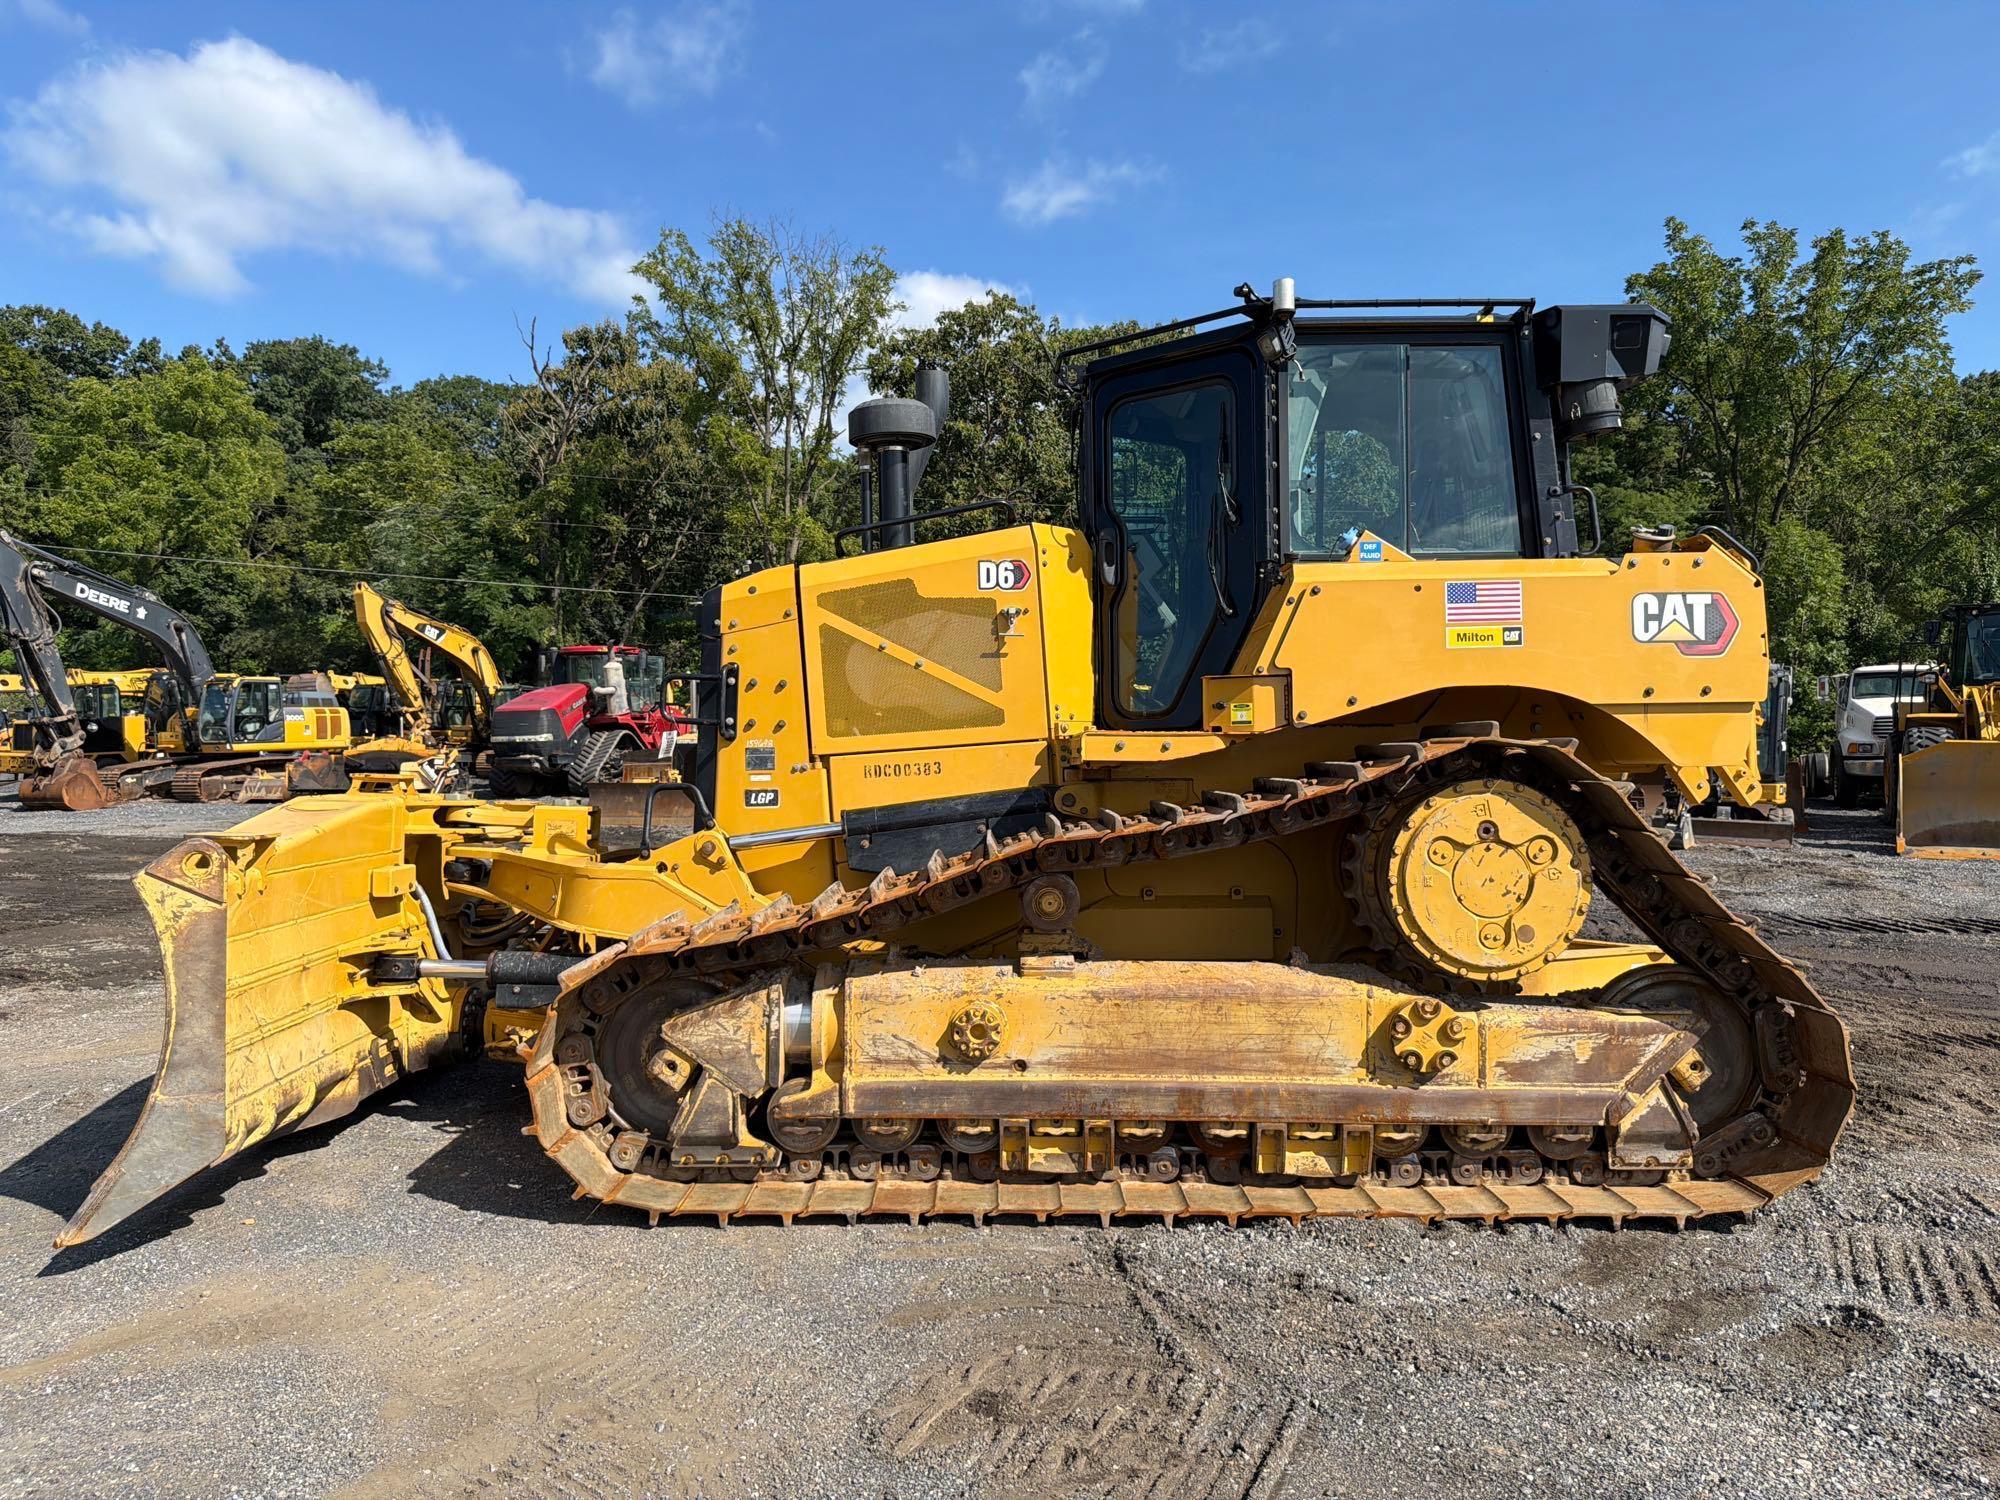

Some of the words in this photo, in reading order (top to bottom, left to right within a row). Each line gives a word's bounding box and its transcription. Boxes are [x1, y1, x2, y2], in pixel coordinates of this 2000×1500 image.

[979, 561, 1015, 589] D6
[75, 582, 131, 614] DEERE
[1632, 593, 1712, 642] CAT
[424, 624, 440, 640] CAT
[1456, 632, 1494, 642] Milton
[1503, 631, 1521, 642] CAT
[864, 761, 942, 779] RDC00383
[750, 792, 775, 804] LGP
